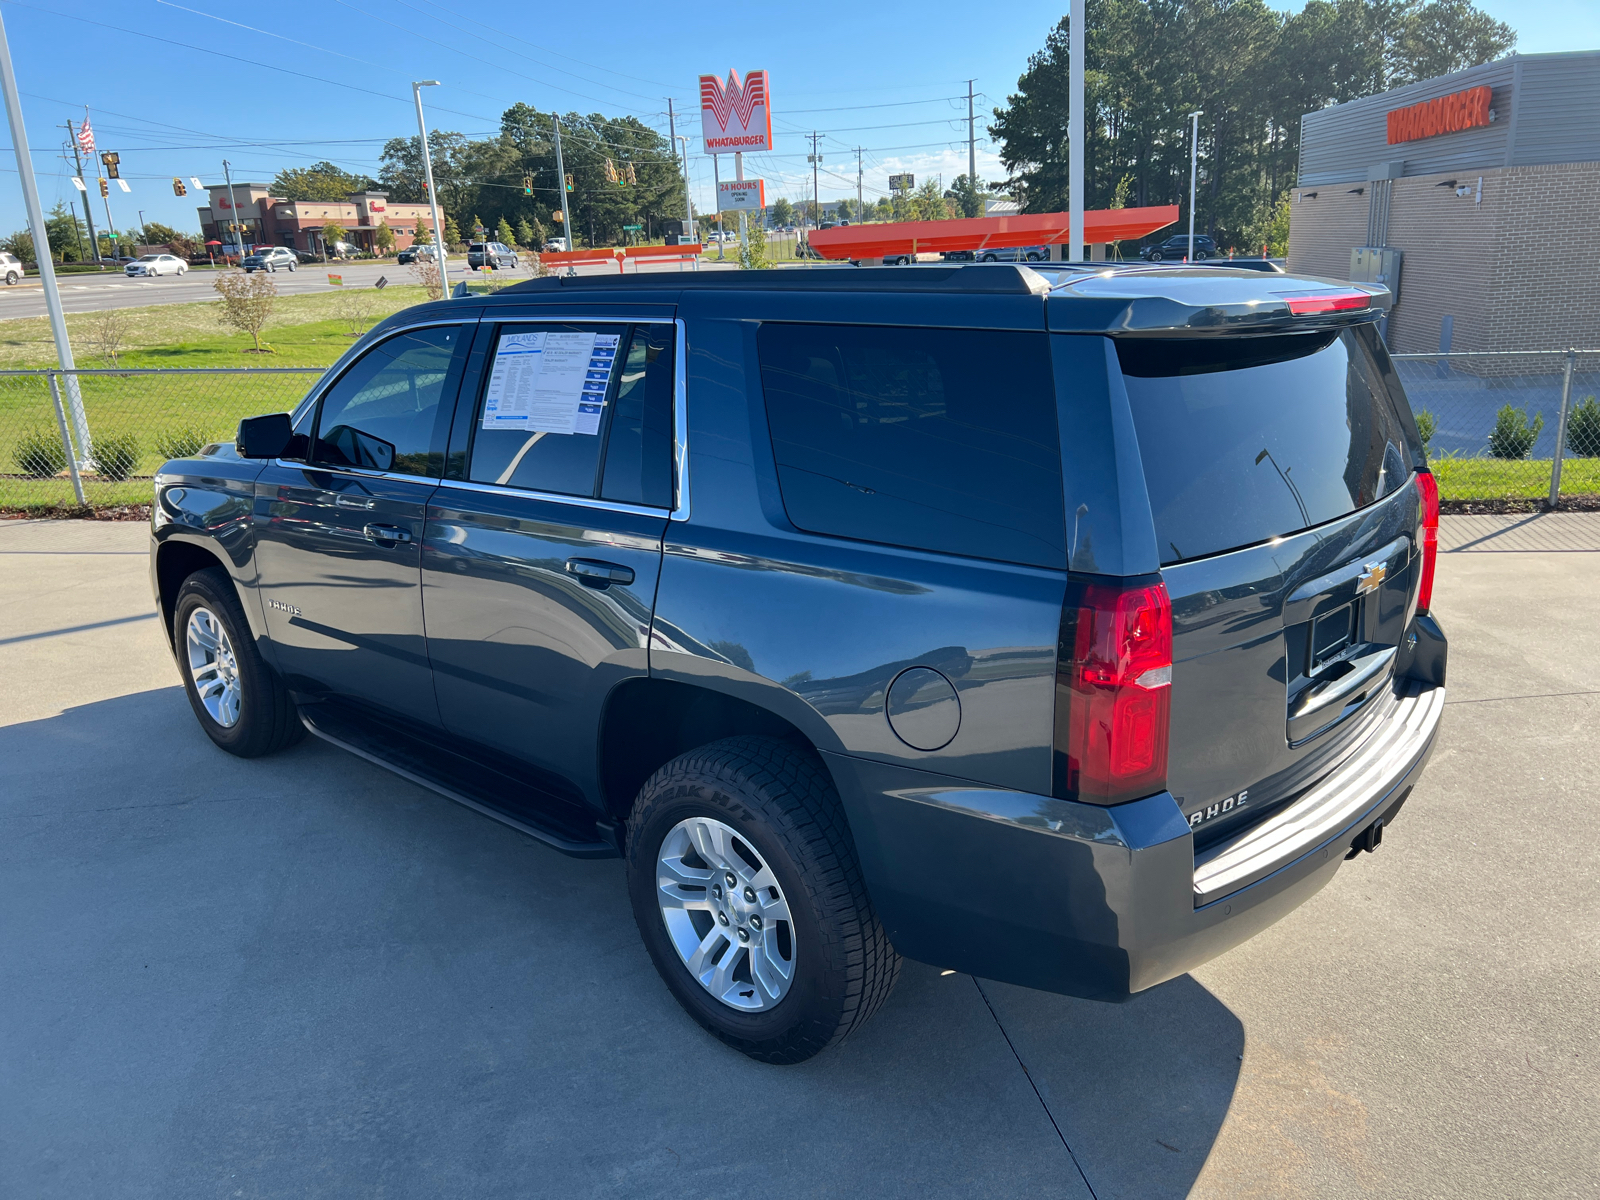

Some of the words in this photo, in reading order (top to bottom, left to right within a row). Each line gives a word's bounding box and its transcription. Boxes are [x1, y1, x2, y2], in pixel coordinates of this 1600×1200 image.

[1387, 85, 1492, 145] WHATABURGER
[706, 134, 765, 149] WHATABURGER
[720, 183, 729, 191] 24
[731, 181, 757, 191] HOURS
[507, 333, 539, 343] MIDLANDS
[268, 598, 302, 616] TAHOE
[711, 791, 757, 821] H/T
[1187, 790, 1249, 827] AHOE
